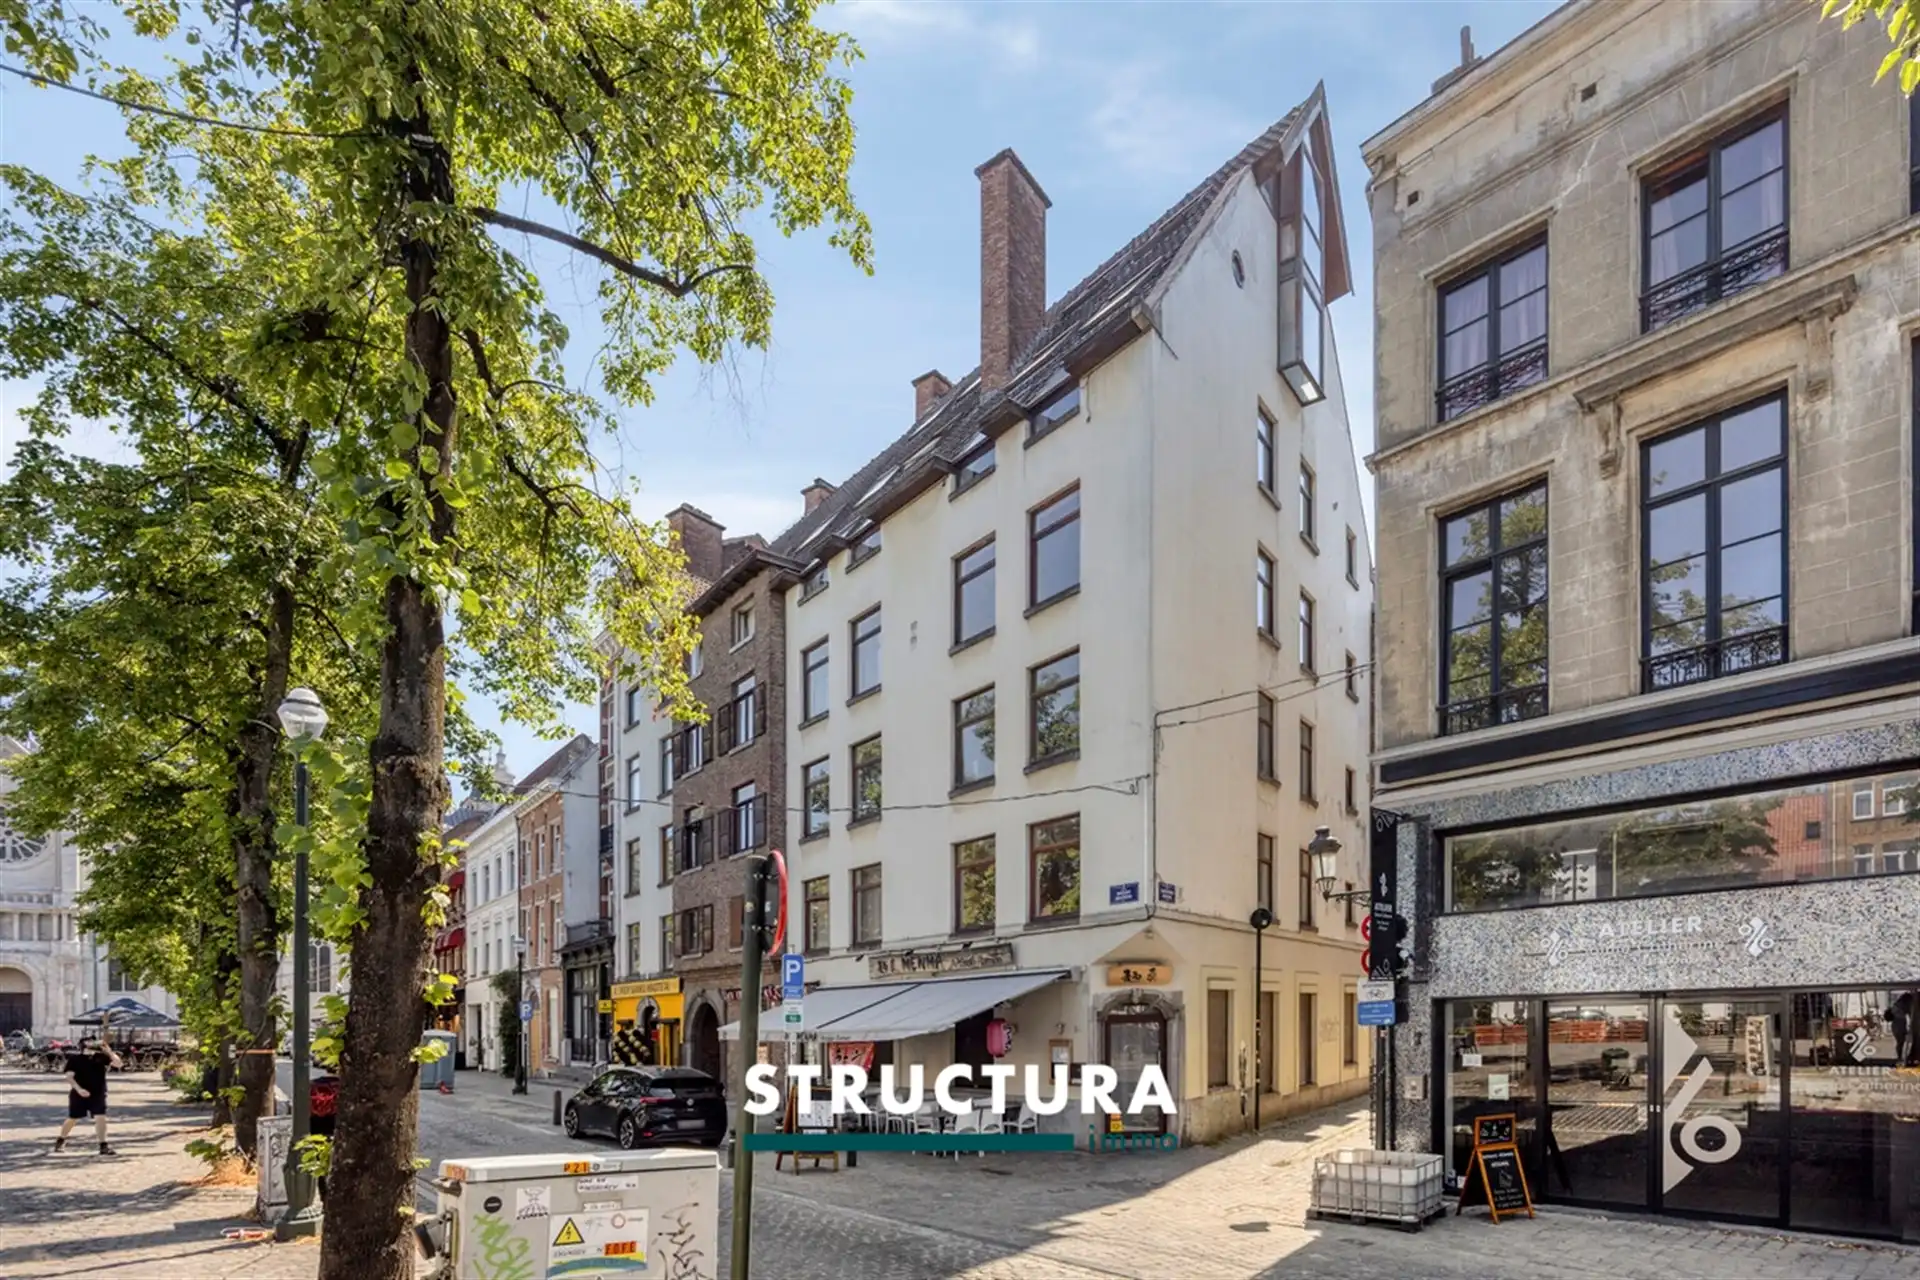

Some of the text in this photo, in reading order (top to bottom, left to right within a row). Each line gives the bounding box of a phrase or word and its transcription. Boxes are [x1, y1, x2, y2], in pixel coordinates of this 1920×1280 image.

[1599, 915, 1703, 938] ATELIER
[786, 960, 800, 983] P
[1830, 1066, 1891, 1076] ATELIER
